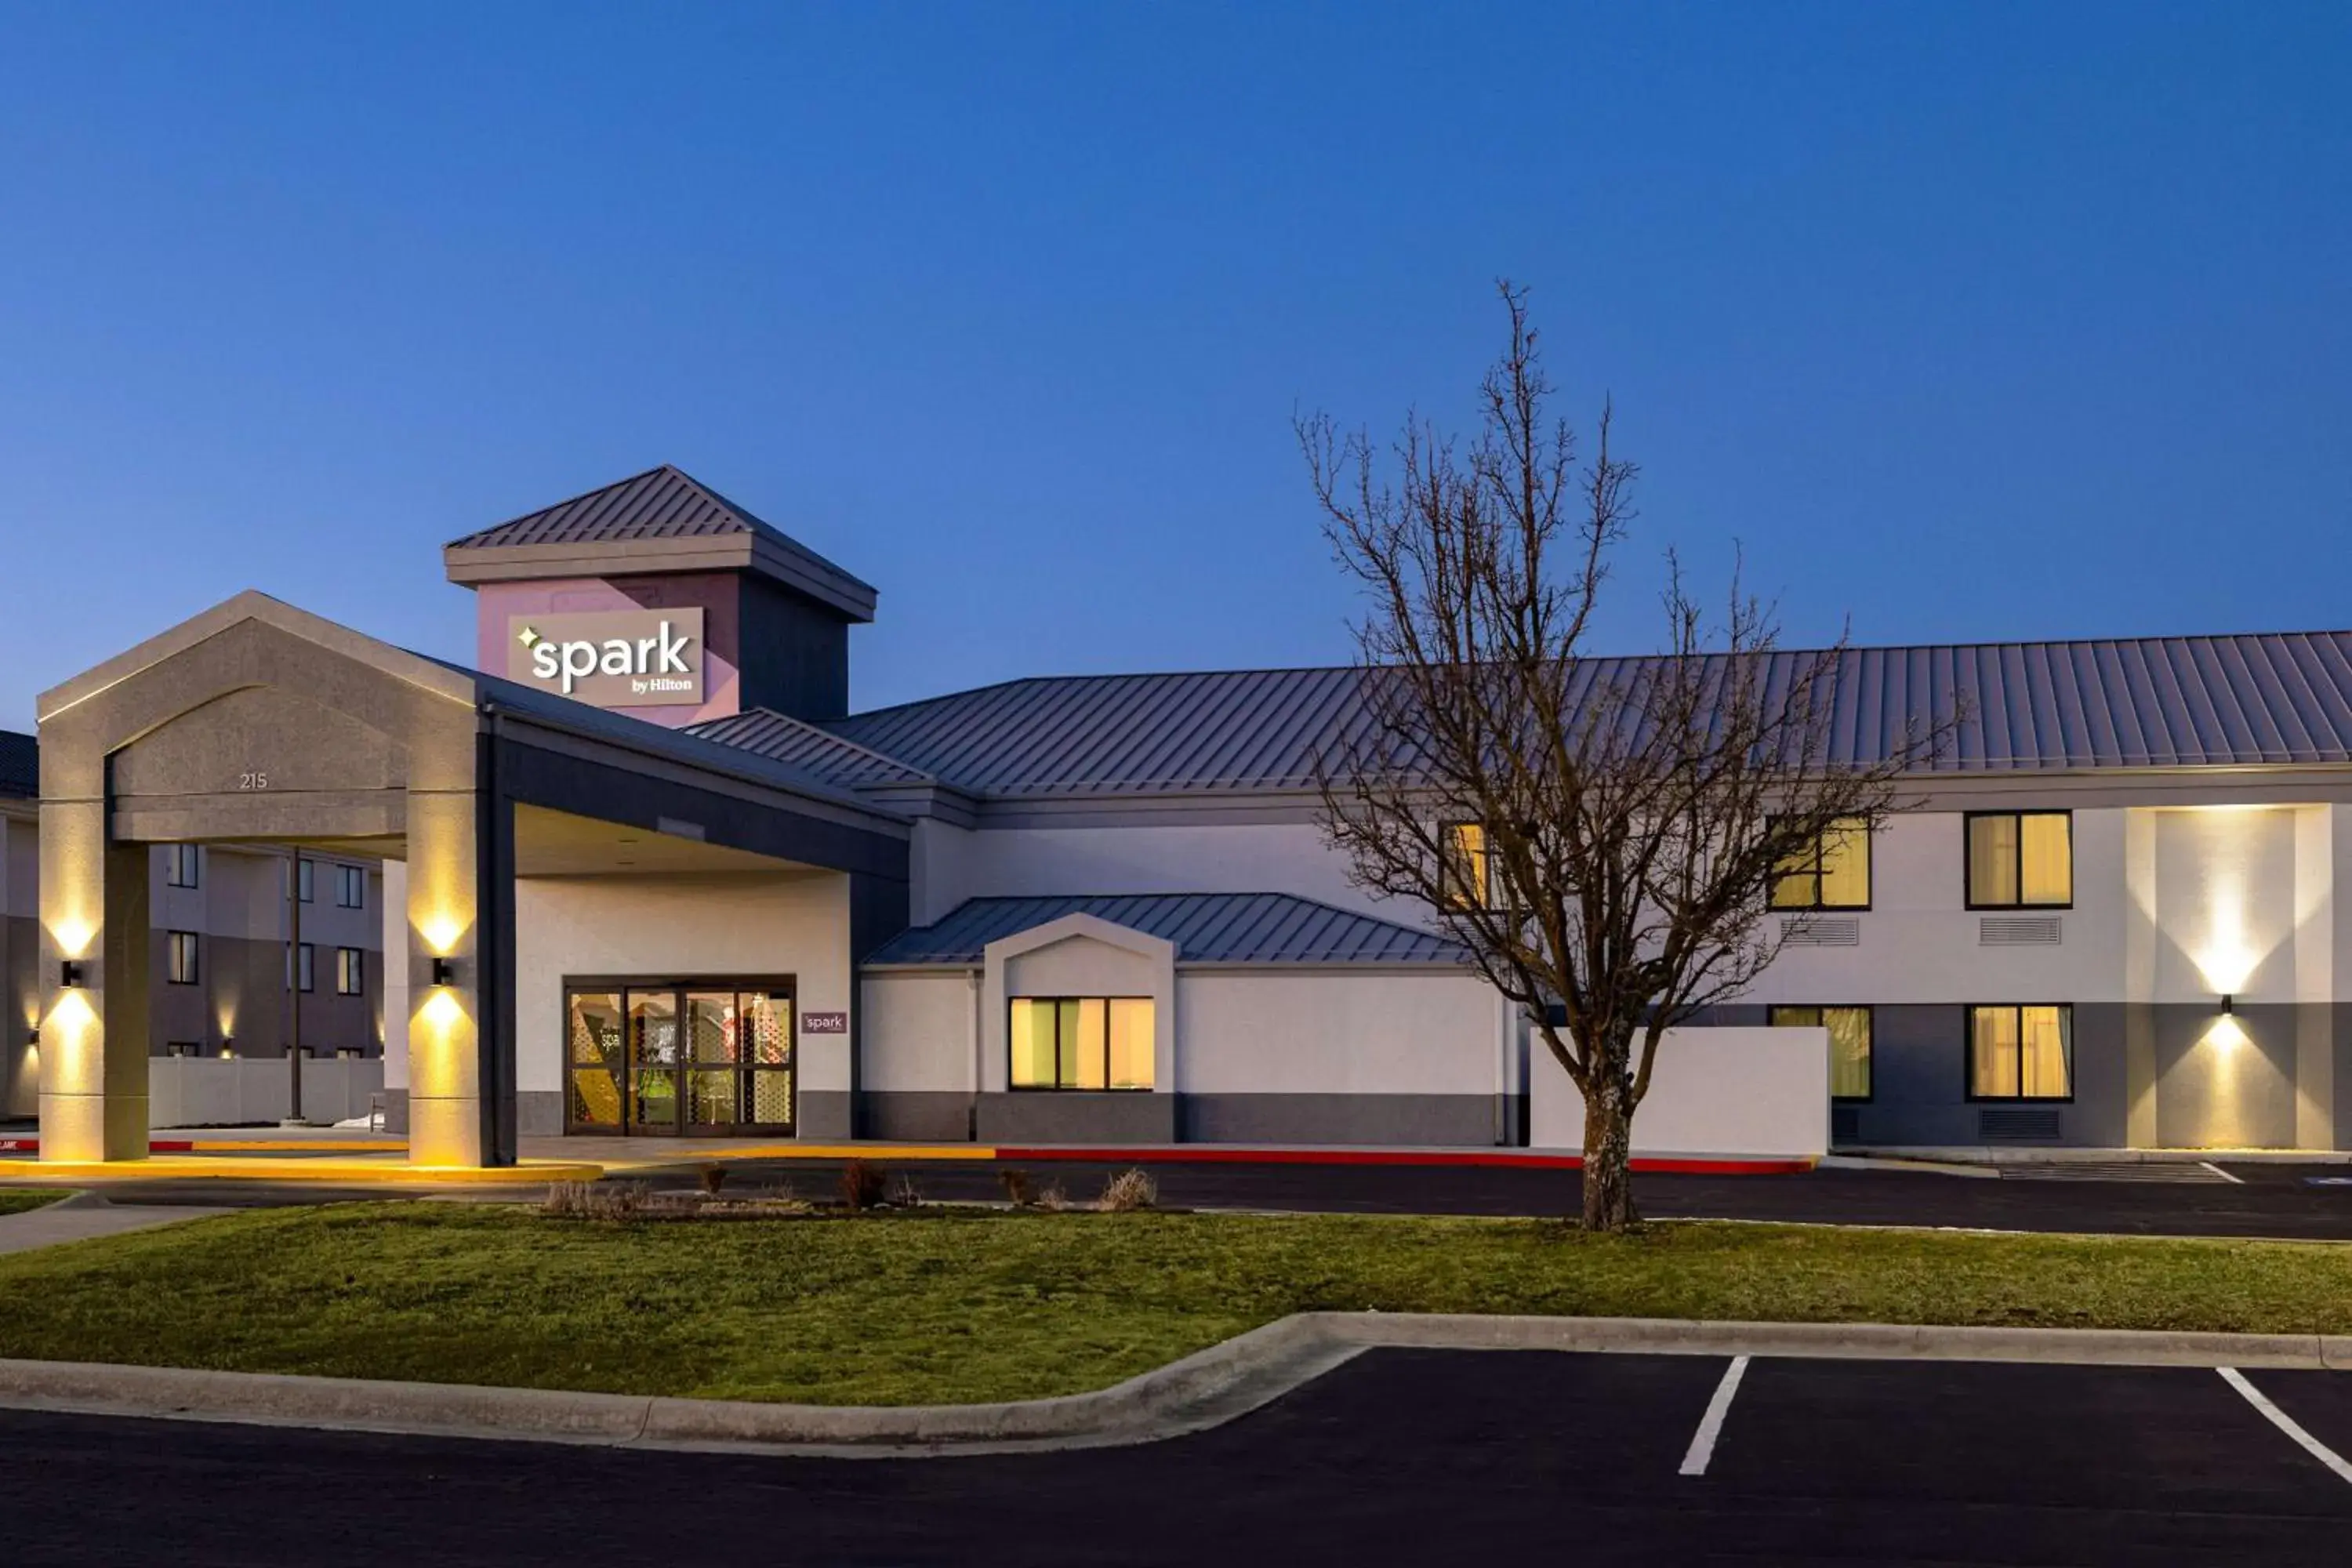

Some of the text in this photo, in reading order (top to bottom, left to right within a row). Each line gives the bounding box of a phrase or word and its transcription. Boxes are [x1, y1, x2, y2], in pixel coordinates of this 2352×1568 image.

[532, 620, 691, 694] spark
[632, 678, 692, 695] by Hilton
[239, 773, 267, 789] 215
[807, 1015, 842, 1031] spark
